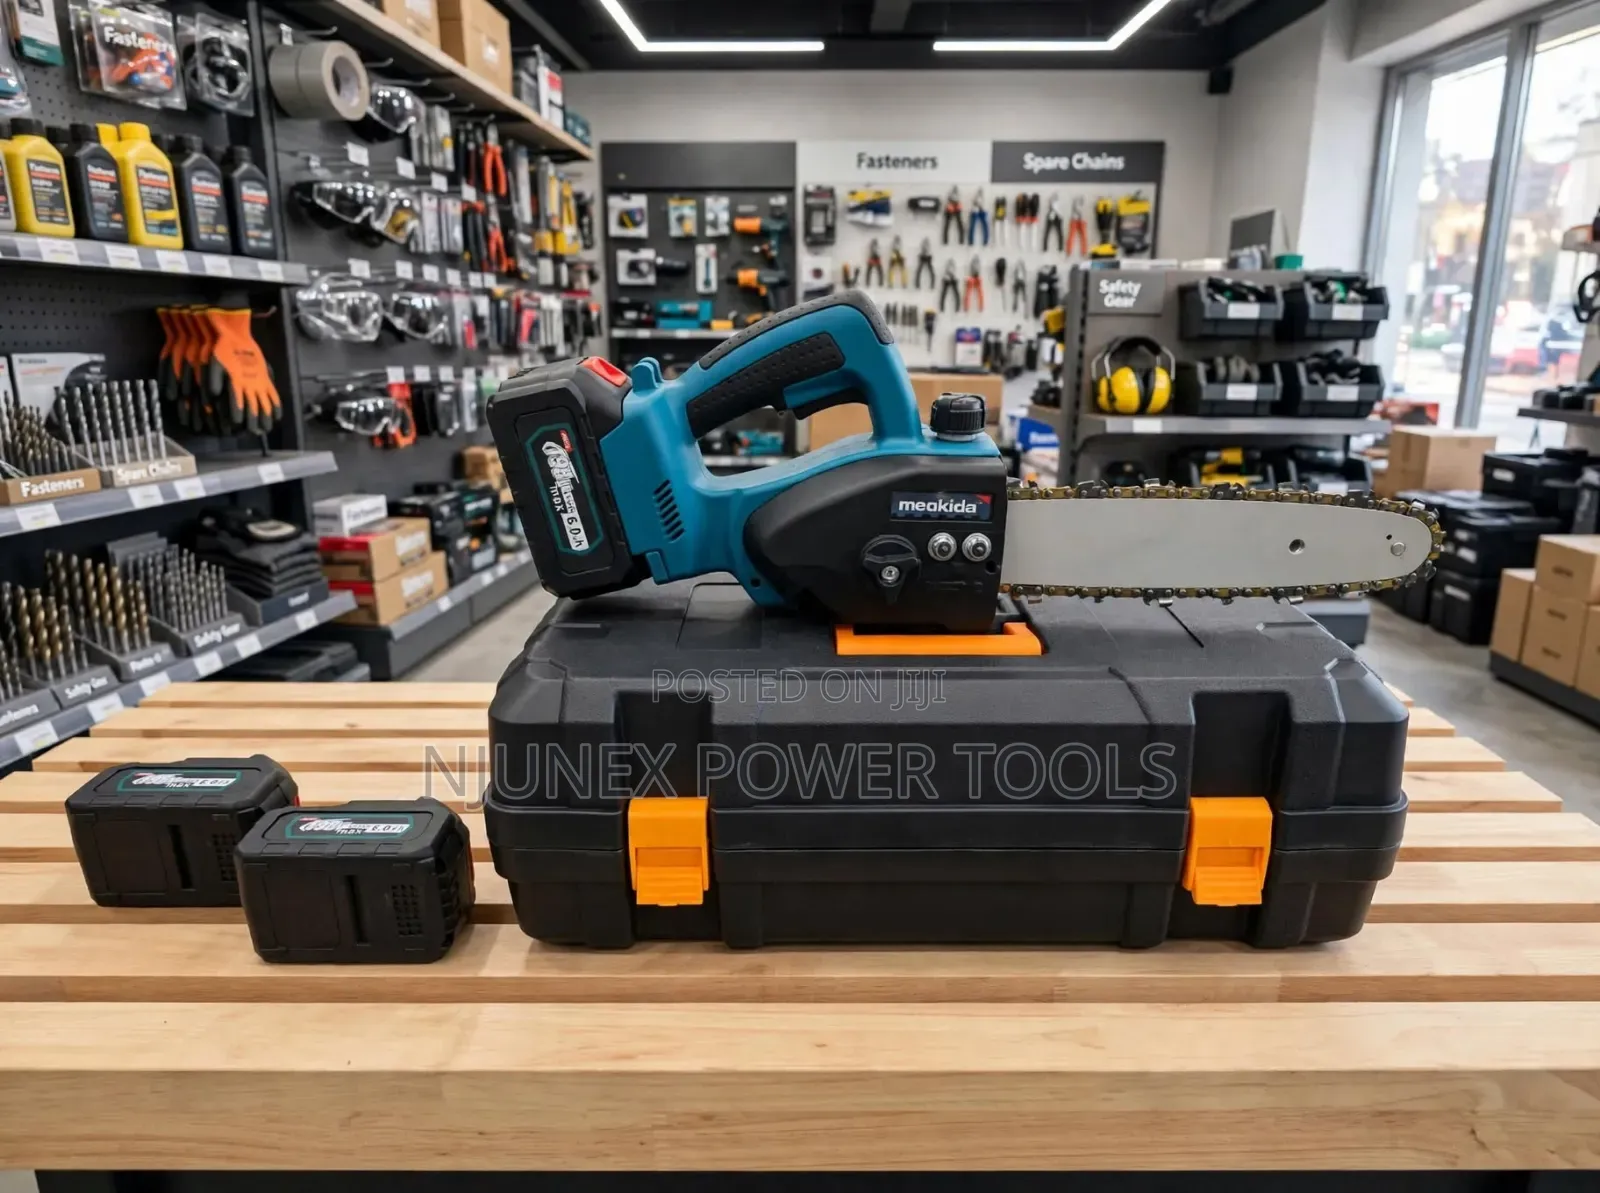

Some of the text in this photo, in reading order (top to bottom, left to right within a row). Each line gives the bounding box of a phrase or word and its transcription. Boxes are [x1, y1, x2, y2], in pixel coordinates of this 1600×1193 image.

[856, 152, 938, 170] Fasteners
[1022, 152, 1125, 174] Spare Chains
[1099, 279, 1141, 297] Safety
[1104, 293, 1136, 308] Gear
[20, 477, 85, 498] Fasteners
[898, 499, 977, 514] meakida
